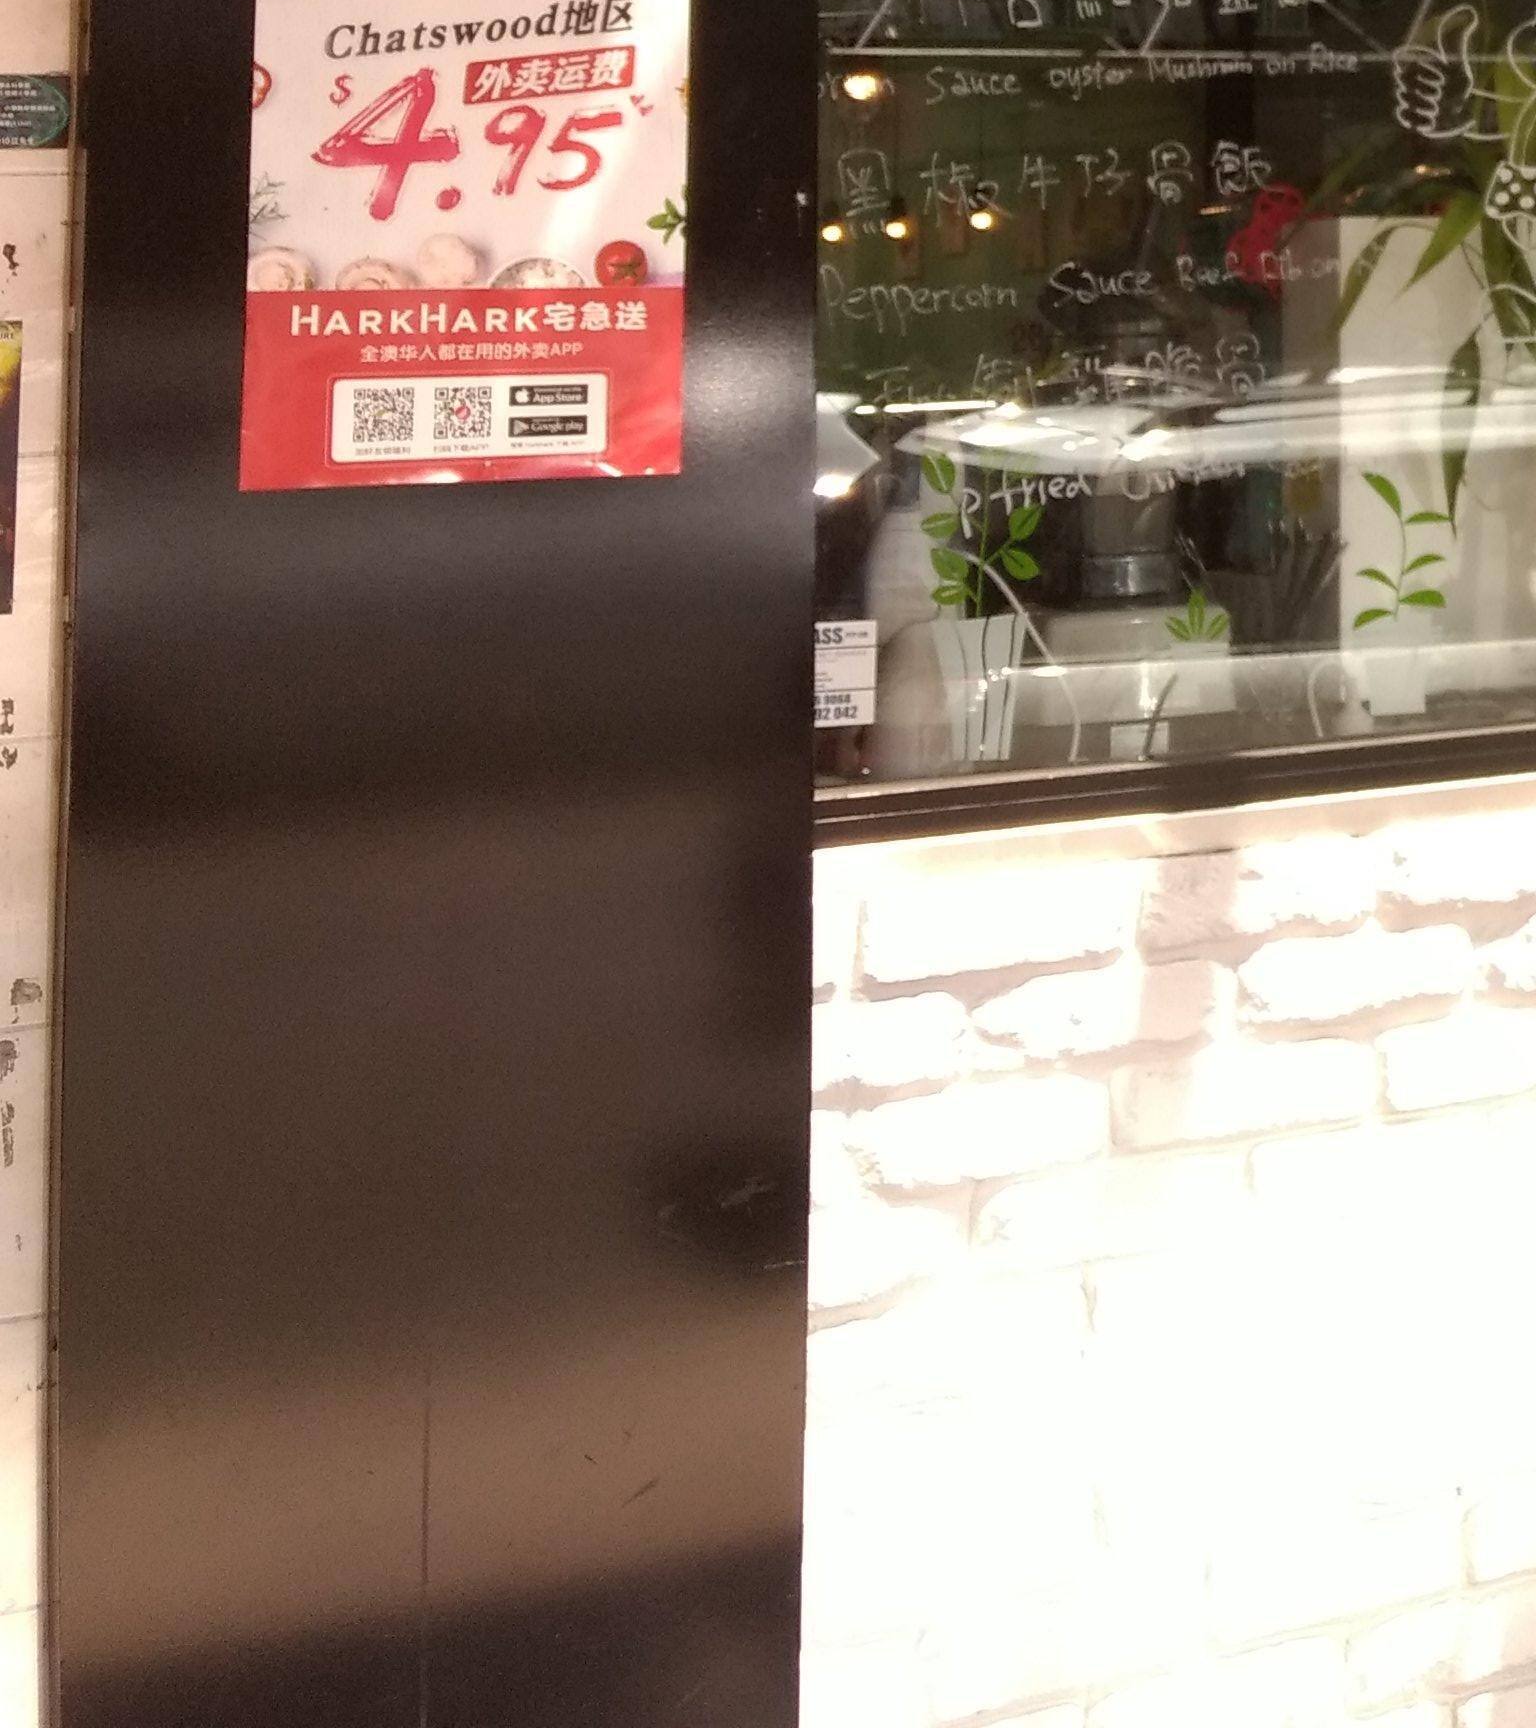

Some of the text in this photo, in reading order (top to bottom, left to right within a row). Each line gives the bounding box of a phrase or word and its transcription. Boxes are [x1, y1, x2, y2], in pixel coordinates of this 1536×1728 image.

[472, 50, 628, 101] 外卖运费
[926, 67, 1022, 104] Sauce
